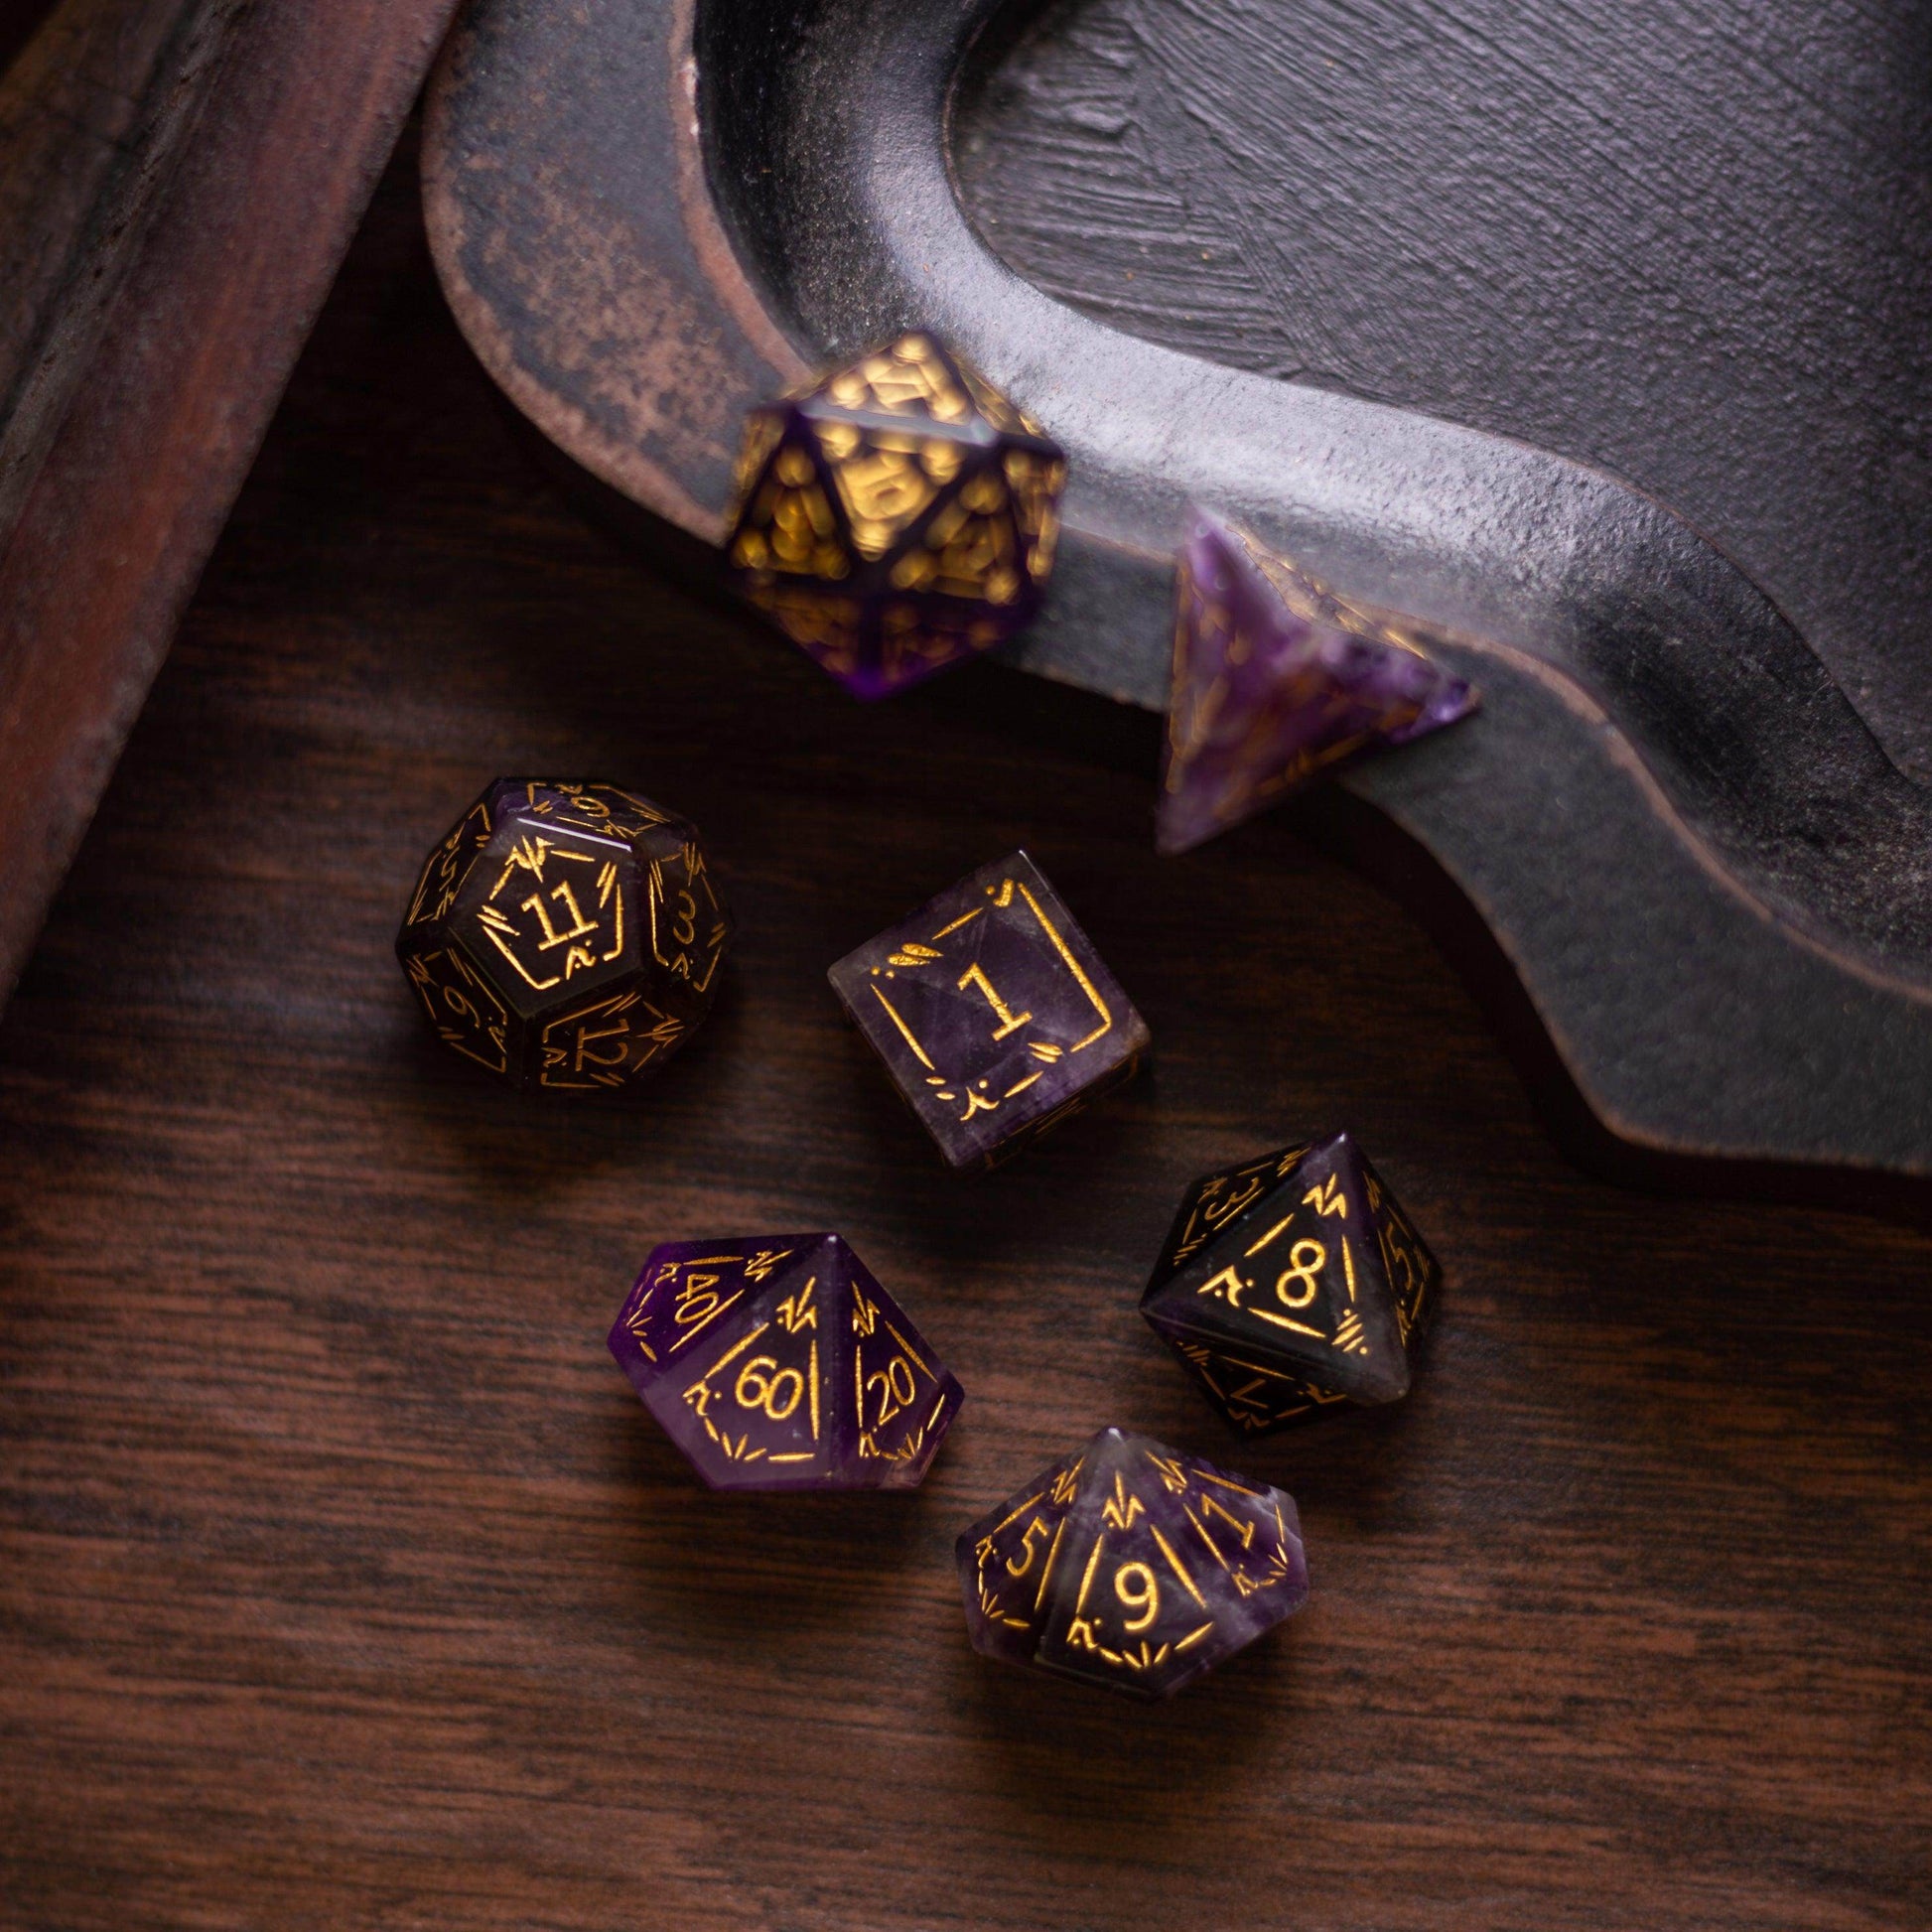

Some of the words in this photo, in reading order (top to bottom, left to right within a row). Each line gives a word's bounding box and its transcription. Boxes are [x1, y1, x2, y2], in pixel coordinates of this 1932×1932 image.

[521, 880, 599, 951] 11
[673, 889, 696, 944] 3
[957, 961, 1033, 1041] 1
[575, 1018, 629, 1072] 12
[1203, 1176, 1260, 1221] 3
[1276, 1237, 1326, 1309] 8
[1386, 1222, 1414, 1291] 5
[674, 1274, 721, 1325] 40
[734, 1354, 805, 1422] 60
[866, 1354, 916, 1426] 20
[1005, 1516, 1049, 1577] 5
[1113, 1561, 1162, 1631] 9
